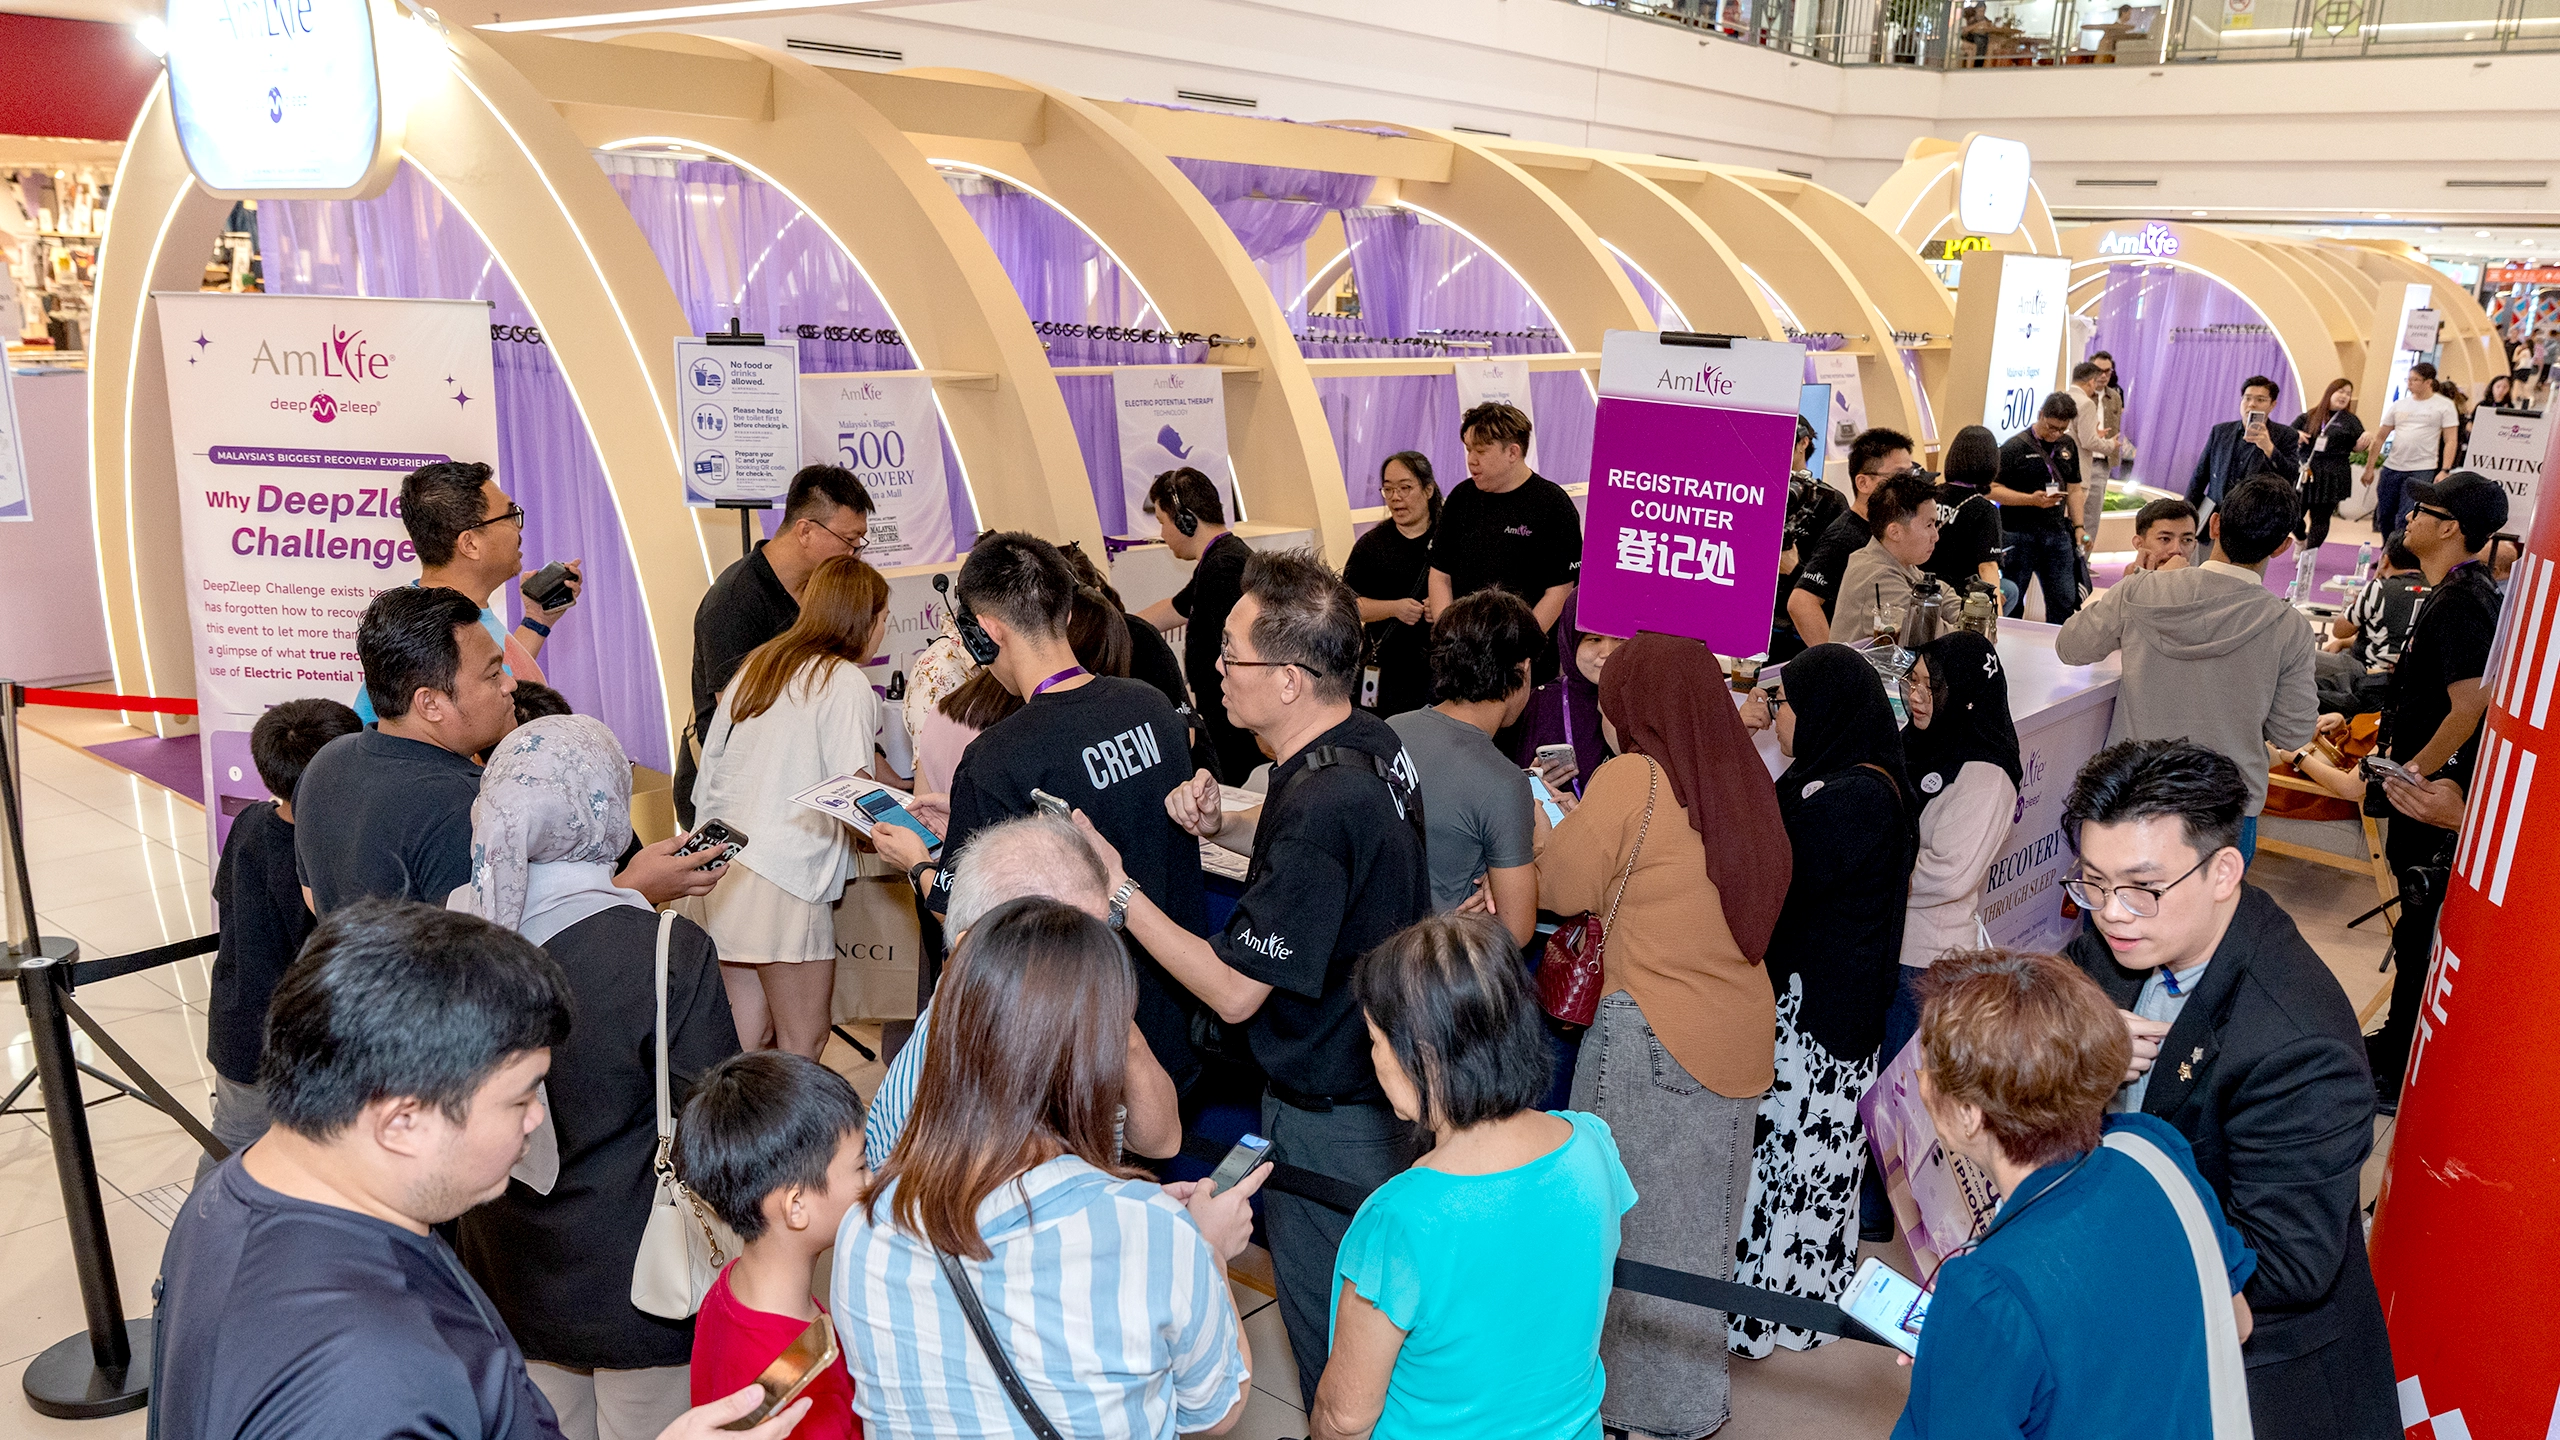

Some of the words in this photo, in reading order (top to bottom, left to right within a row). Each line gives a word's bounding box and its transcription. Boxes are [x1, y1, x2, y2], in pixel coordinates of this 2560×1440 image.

[730, 361, 742, 369] No
[744, 361, 763, 369] food
[841, 381, 882, 400] AmLife
[1657, 361, 1734, 397] AmLife
[270, 397, 308, 415] deep
[1153, 409, 1188, 417] TECHNOLOGY
[2001, 387, 2034, 430] 500
[838, 421, 872, 430] Malaysia's
[873, 420, 896, 429] Biggest
[217, 451, 275, 463] MALAYSIA'S
[277, 453, 322, 464] BIGGEST
[324, 455, 378, 466] RECOVERY
[838, 430, 905, 471] 500
[857, 470, 915, 488] COVERY
[1608, 468, 1765, 506] REGISTRATION
[206, 491, 250, 513] Why
[256, 484, 402, 523] DeepZle
[872, 491, 880, 500] in
[886, 489, 902, 499] Mall
[1630, 499, 1734, 531] COUNTER
[1936, 503, 1959, 524] REW
[870, 525, 897, 534] MALAYSIA
[231, 526, 418, 570] Challenge
[1615, 526, 1736, 587] 登记处
[203, 579, 261, 594] DeepZleep
[266, 583, 325, 598] Challenge
[331, 586, 364, 598] exists
[204, 601, 222, 613] has
[225, 603, 278, 617] forgotten
[282, 604, 307, 616] how
[311, 606, 324, 617] to
[327, 609, 363, 619] recov
[887, 601, 940, 635] AmLif
[206, 622, 225, 634] this
[227, 624, 259, 636] event
[262, 625, 274, 636] to
[278, 626, 294, 637] let
[298, 629, 329, 639] more
[208, 645, 214, 654] a
[216, 645, 258, 659] glimpse
[261, 646, 273, 657] of
[276, 648, 306, 660] what
[309, 649, 336, 660] true
[209, 666, 226, 677] use
[229, 666, 240, 677] of
[244, 667, 292, 680] Electric
[297, 669, 353, 682] Potential
[1082, 722, 1162, 790] CREW
[2023, 748, 2045, 790] Life
[1986, 827, 2063, 895] RECOVERY
[1982, 883, 2029, 926] THROUGH
[2030, 867, 2057, 898] SLEEP
[835, 942, 894, 961] NCCI
[1237, 928, 1290, 961] AmLife
[2427, 928, 2461, 1026] RE
[1954, 1158, 1989, 1235] iPHONE
